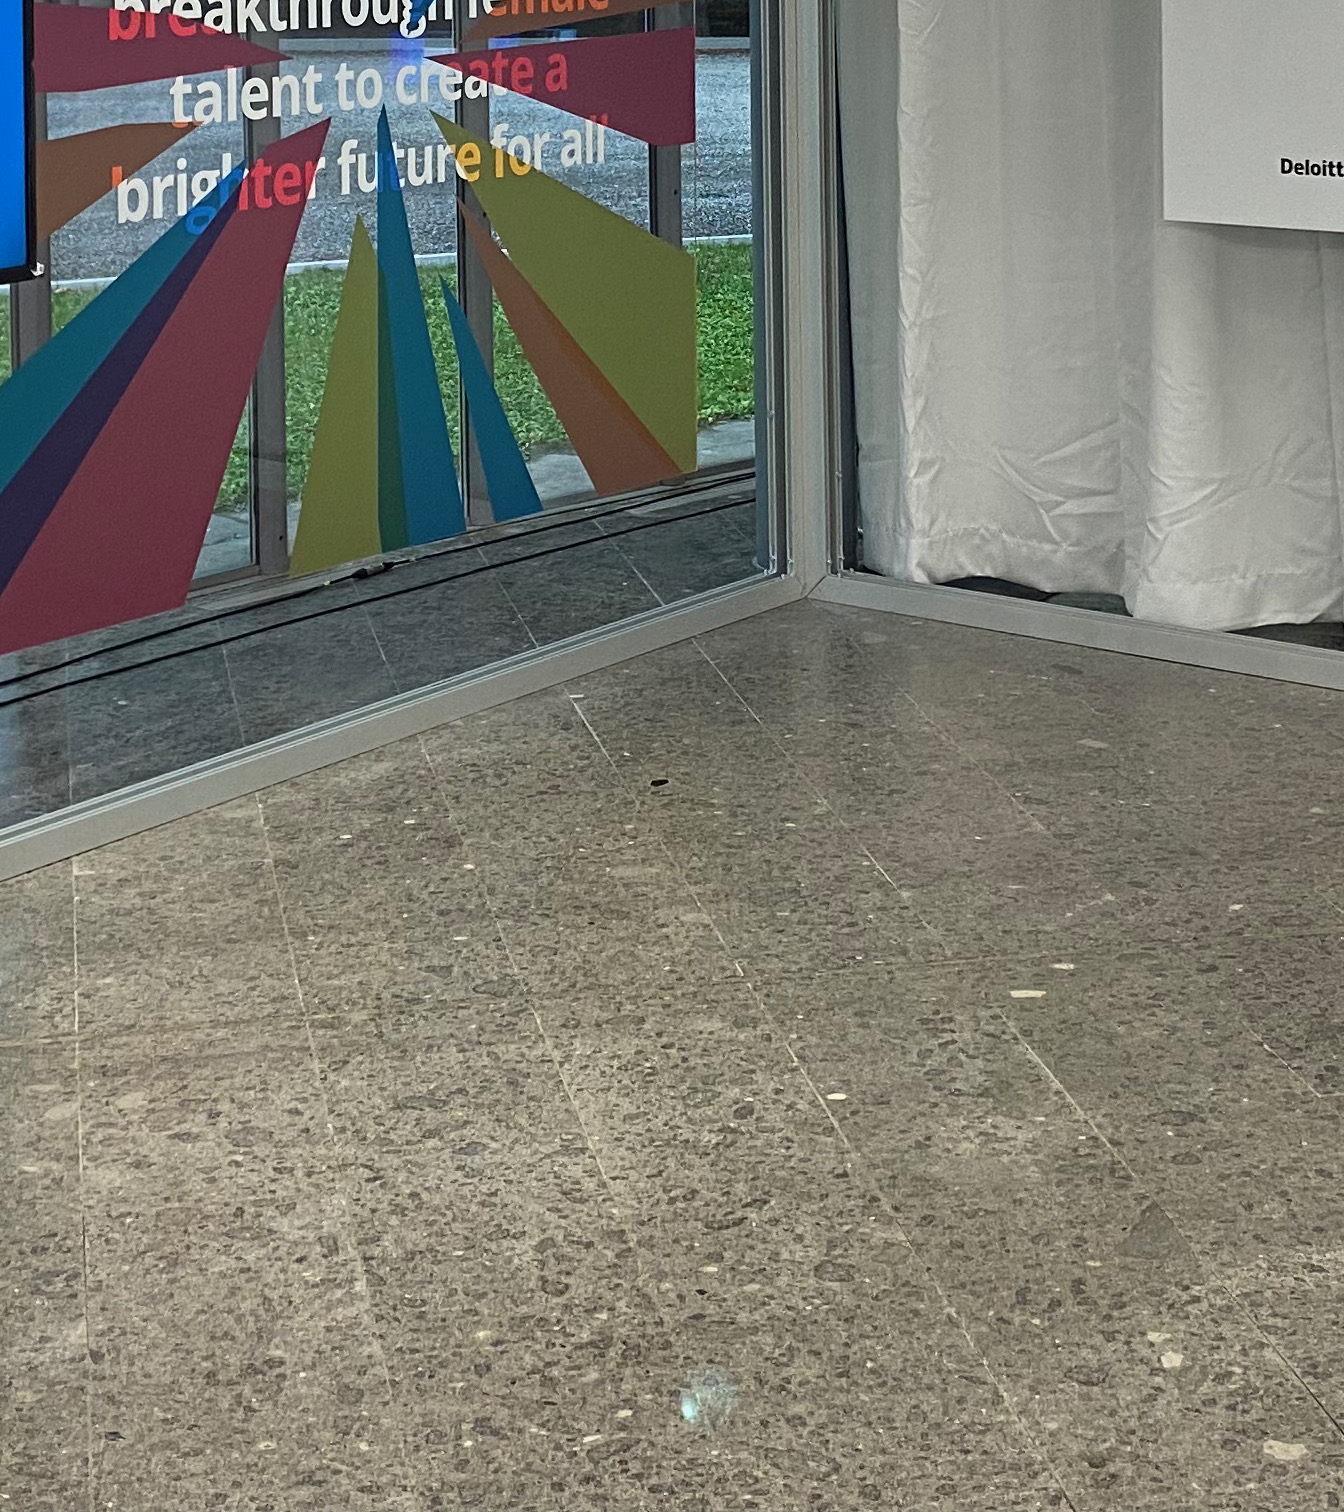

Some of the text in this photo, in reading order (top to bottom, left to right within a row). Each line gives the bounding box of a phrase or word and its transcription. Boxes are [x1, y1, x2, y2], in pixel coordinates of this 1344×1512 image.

[169, 51, 568, 128] talent to create a
[111, 112, 609, 235] brighter future for all
